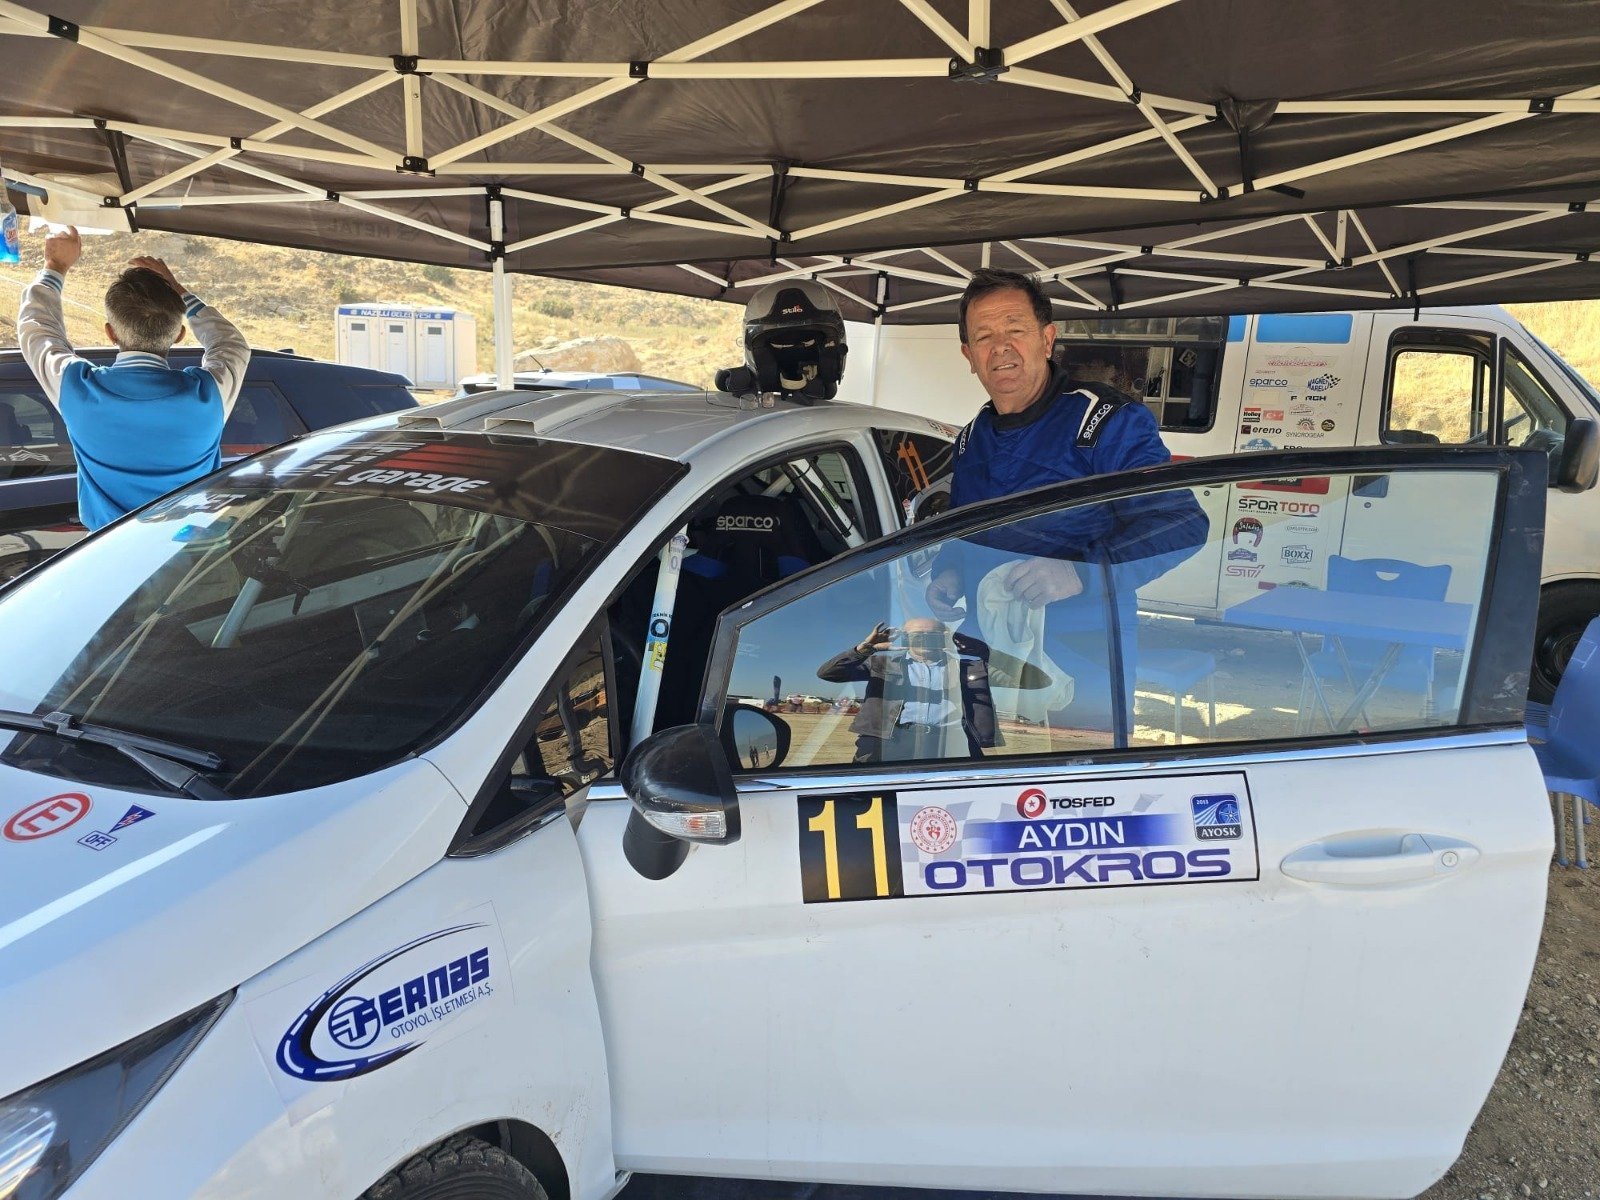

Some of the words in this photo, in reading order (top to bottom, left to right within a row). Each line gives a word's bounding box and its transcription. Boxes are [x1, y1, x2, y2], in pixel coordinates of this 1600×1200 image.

[1249, 378, 1288, 387] sparco
[1082, 403, 1112, 440] sparco
[334, 469, 491, 494] garage
[716, 515, 773, 531] sparco
[1284, 549, 1310, 560] BOXX
[1049, 795, 1115, 809] TOSFED
[18, 800, 78, 833] E
[84, 833, 112, 847] OFF
[1018, 820, 1125, 849] AYDIN
[1201, 827, 1237, 837] AYOSK
[808, 797, 889, 899] 11
[925, 848, 1231, 890] OTOKROS
[391, 1013, 433, 1038] OTOYOL
